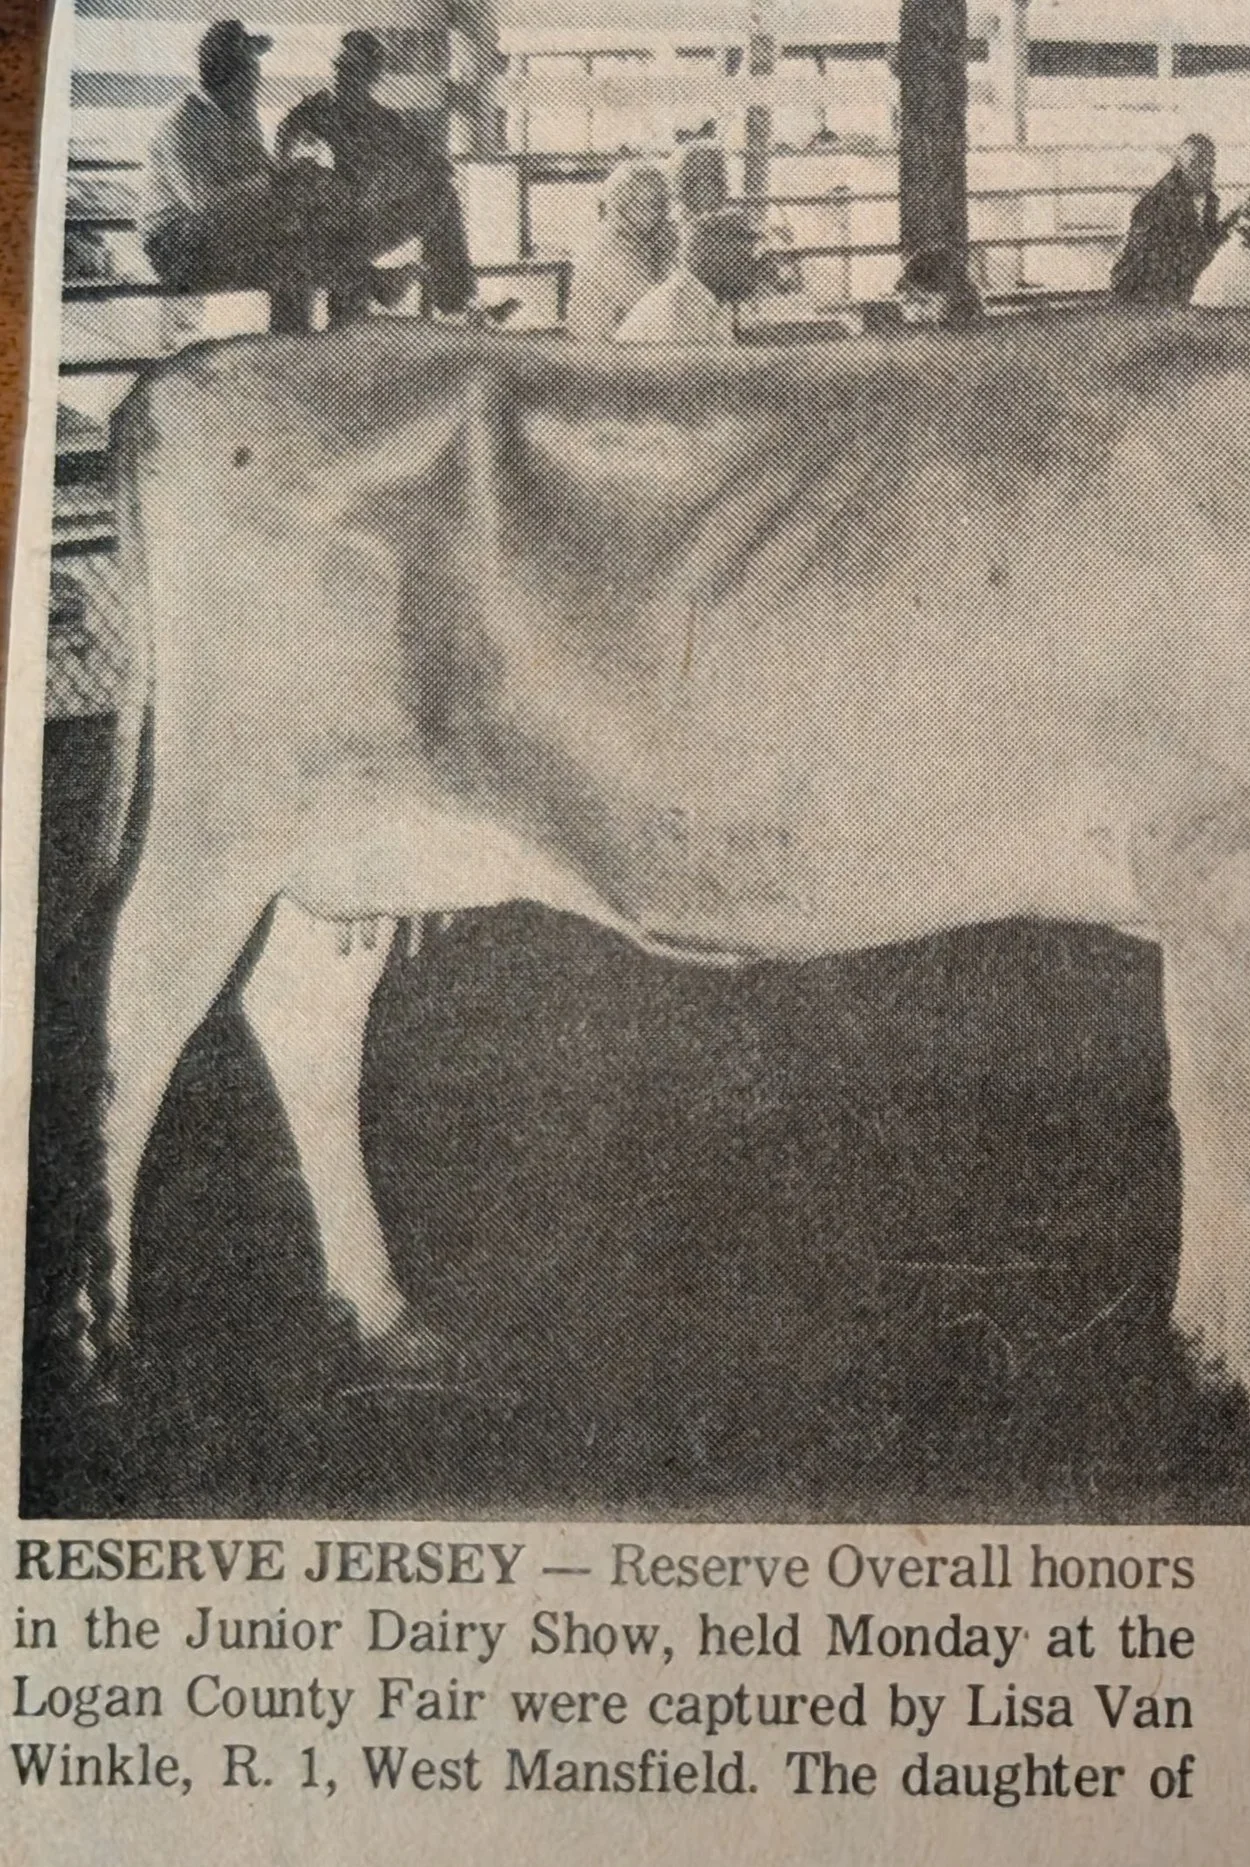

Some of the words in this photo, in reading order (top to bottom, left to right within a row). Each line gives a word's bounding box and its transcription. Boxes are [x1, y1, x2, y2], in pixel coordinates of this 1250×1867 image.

[14, 1538, 285, 1582] RESERVE
[304, 1541, 526, 1585] JERSEY
[610, 1543, 810, 1589] Reserve
[827, 1543, 1013, 1589] Overall
[1029, 1543, 1195, 1590] honors
[13, 1605, 58, 1650] in
[84, 1605, 160, 1650] the
[185, 1606, 343, 1652] Junior
[367, 1608, 507, 1665] Dairy
[530, 1610, 674, 1666] Show,
[698, 1612, 802, 1658] held
[826, 1612, 1022, 1669] Monday
[1046, 1615, 1096, 1659] at
[1118, 1613, 1195, 1660] the
[12, 1674, 163, 1729] Logan
[186, 1674, 355, 1731] County
[377, 1677, 486, 1722] Fair
[510, 1691, 628, 1725] were
[648, 1682, 868, 1737] captured
[888, 1682, 947, 1738] by
[966, 1682, 1074, 1729] Lisa
[1093, 1684, 1194, 1729] Van
[9, 1742, 193, 1797] Winkle,
[222, 1744, 273, 1788] R.
[301, 1746, 337, 1798] 1,
[361, 1745, 483, 1792] West
[504, 1748, 758, 1795] Mansfield.
[785, 1750, 878, 1797] The
[901, 1751, 1126, 1809] daughter
[1149, 1753, 1196, 1800] of
